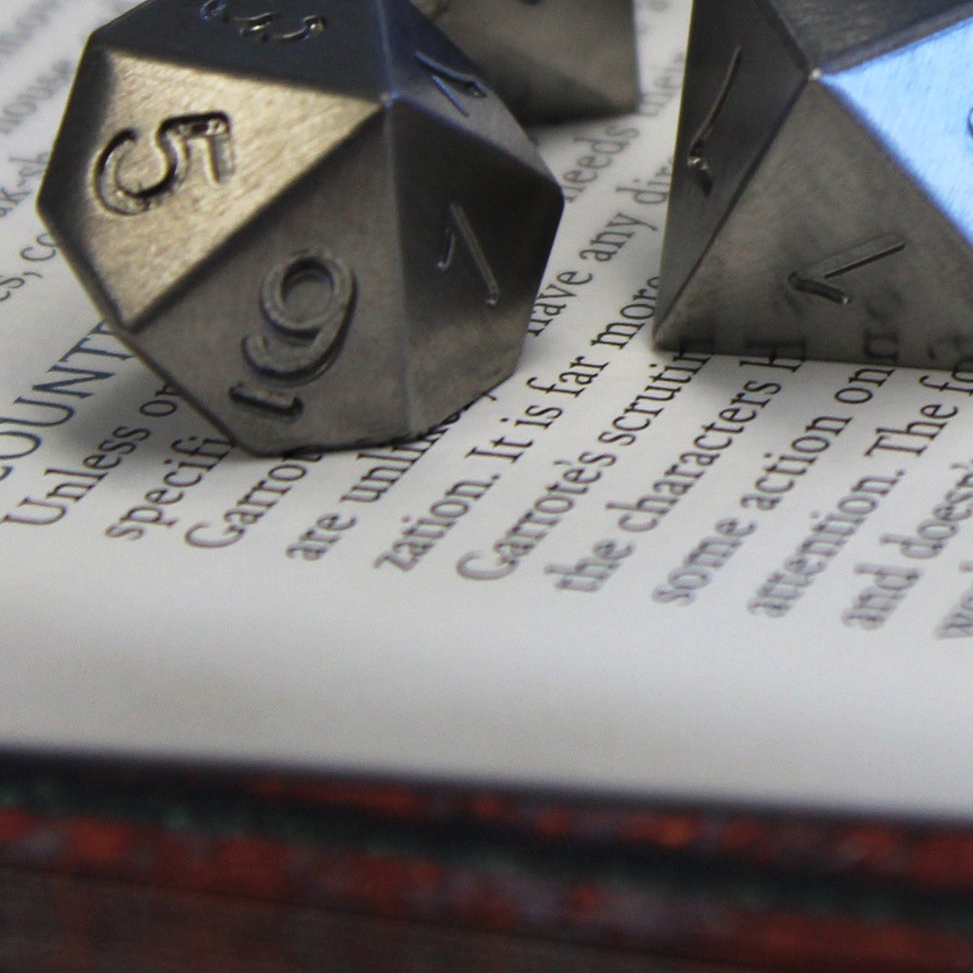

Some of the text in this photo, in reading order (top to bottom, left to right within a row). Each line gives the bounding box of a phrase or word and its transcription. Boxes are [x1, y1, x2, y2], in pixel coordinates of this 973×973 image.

[93, 110, 234, 216] 5
[286, 512, 358, 561] are
[579, 212, 658, 263] any
[499, 405, 563, 430] is
[526, 356, 611, 399] far
[1, 425, 152, 525] Unless
[464, 437, 536, 464] It
[544, 538, 634, 593] the
[605, 379, 783, 533] characters
[375, 474, 501, 572] zation.
[651, 516, 757, 607] some
[739, 416, 853, 512] action
[746, 468, 907, 618] attention.
[863, 402, 960, 459] The
[842, 561, 922, 631] and
